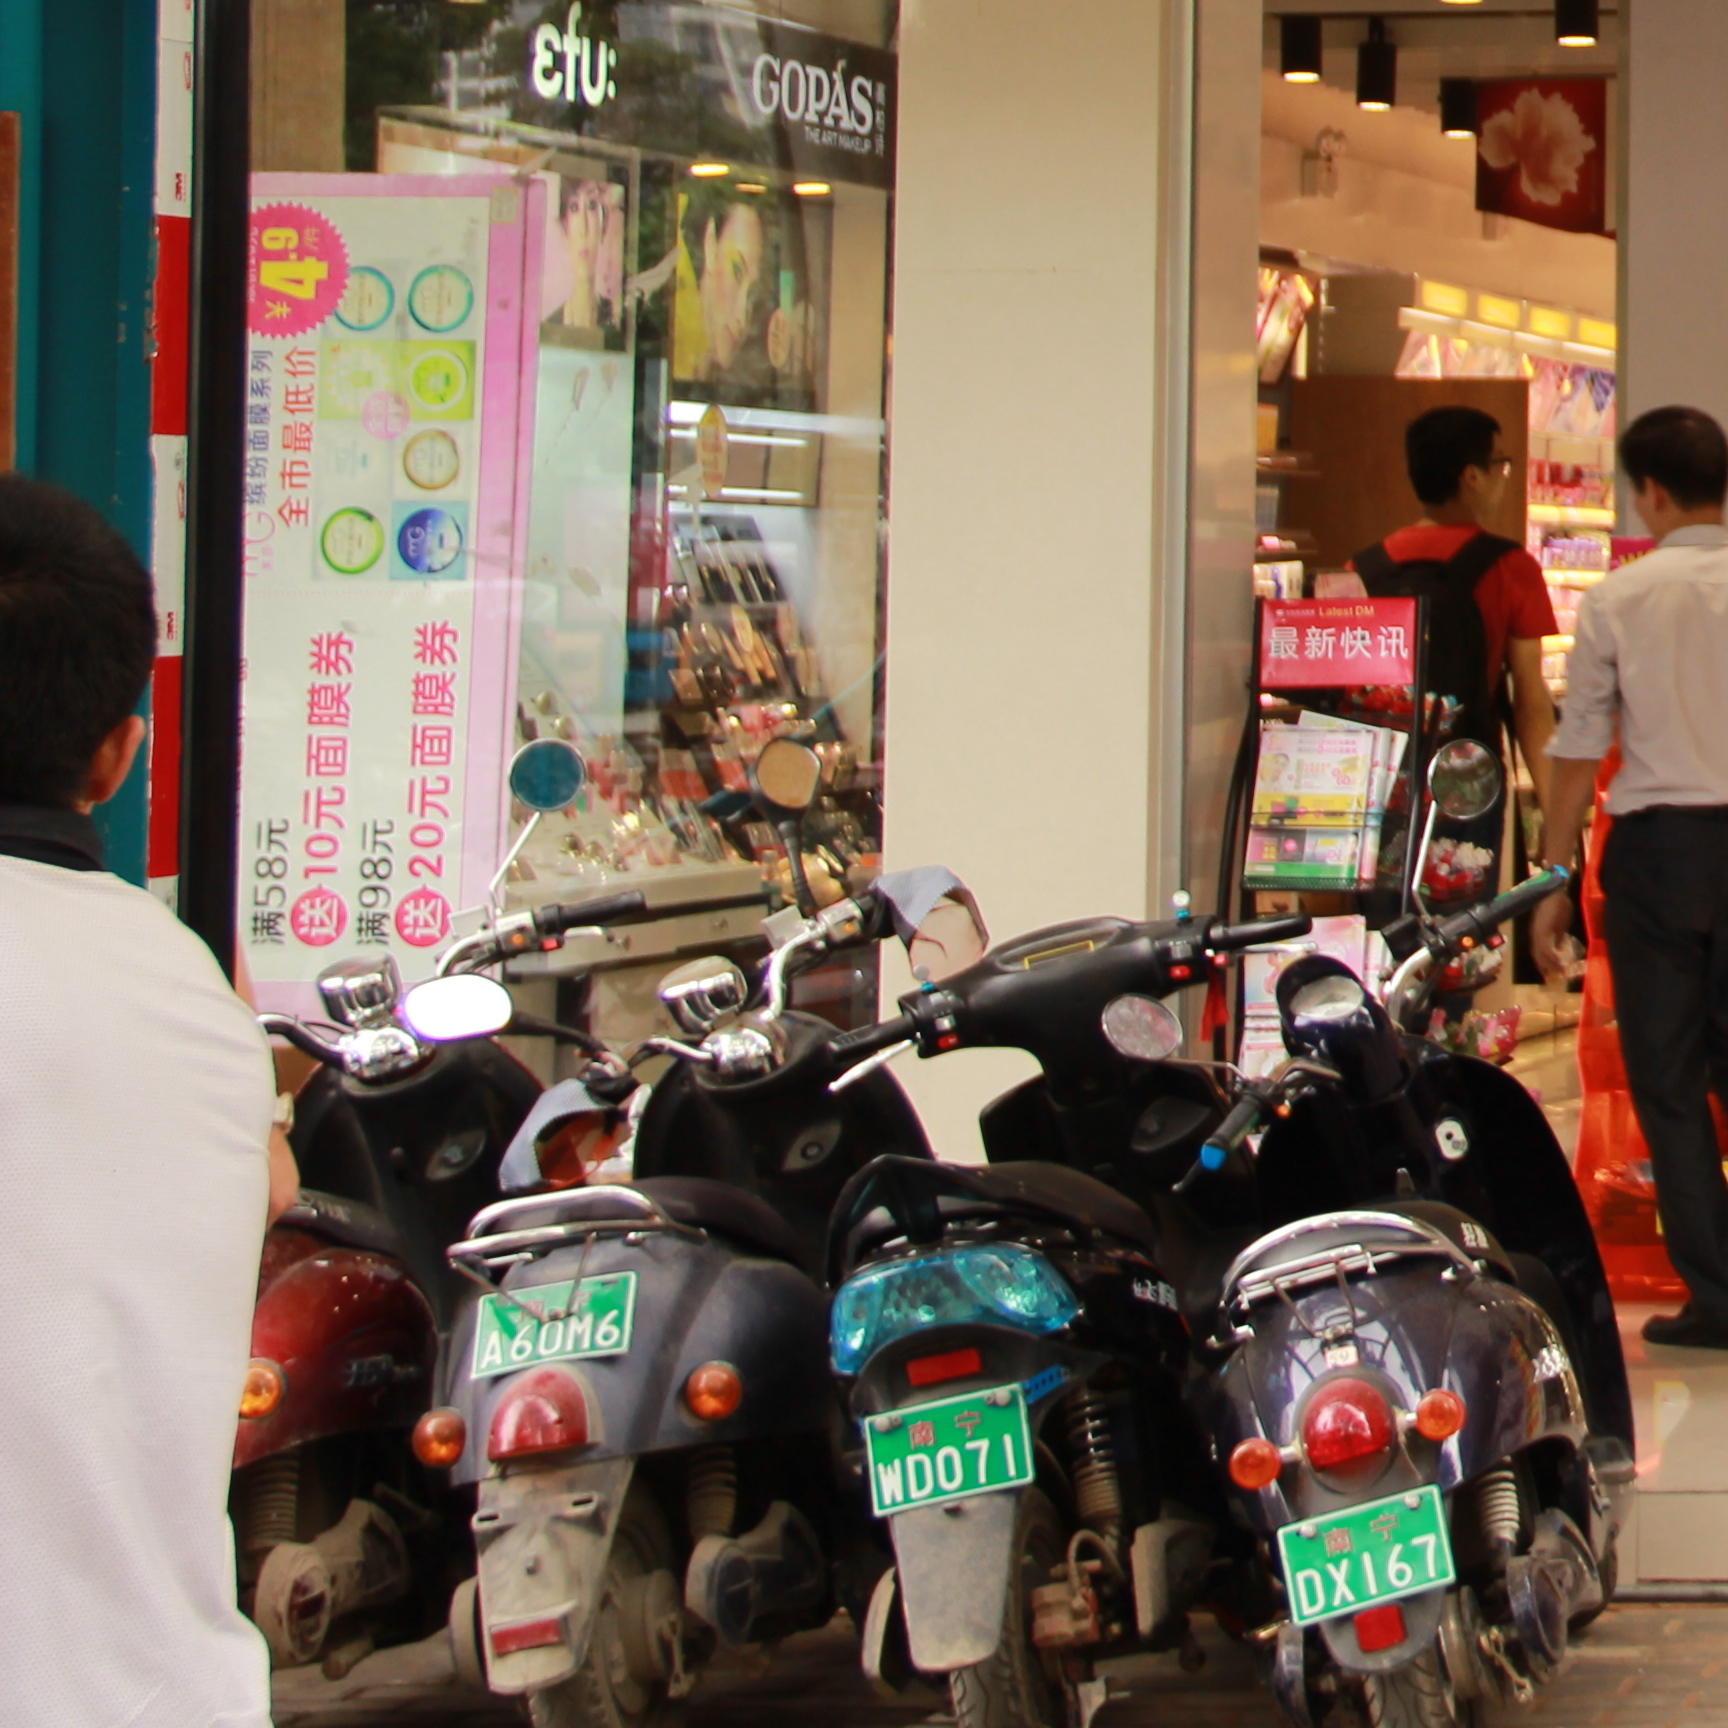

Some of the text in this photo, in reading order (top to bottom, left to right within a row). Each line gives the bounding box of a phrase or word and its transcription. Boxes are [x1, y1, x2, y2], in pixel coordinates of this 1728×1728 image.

[277, 345, 317, 528] 全市最低价
[1268, 624, 1410, 660] 最新快讯
[1318, 605, 1353, 617] Latest
[1354, 605, 1375, 617] DM
[252, 817, 290, 946] 满58元
[356, 818, 394, 946] 满98元
[908, 1409, 983, 1450] 南宁
[877, 1433, 1018, 1507] WD071
[1323, 1513, 1400, 1558] 南宁
[1295, 1532, 1438, 1617] DX167
